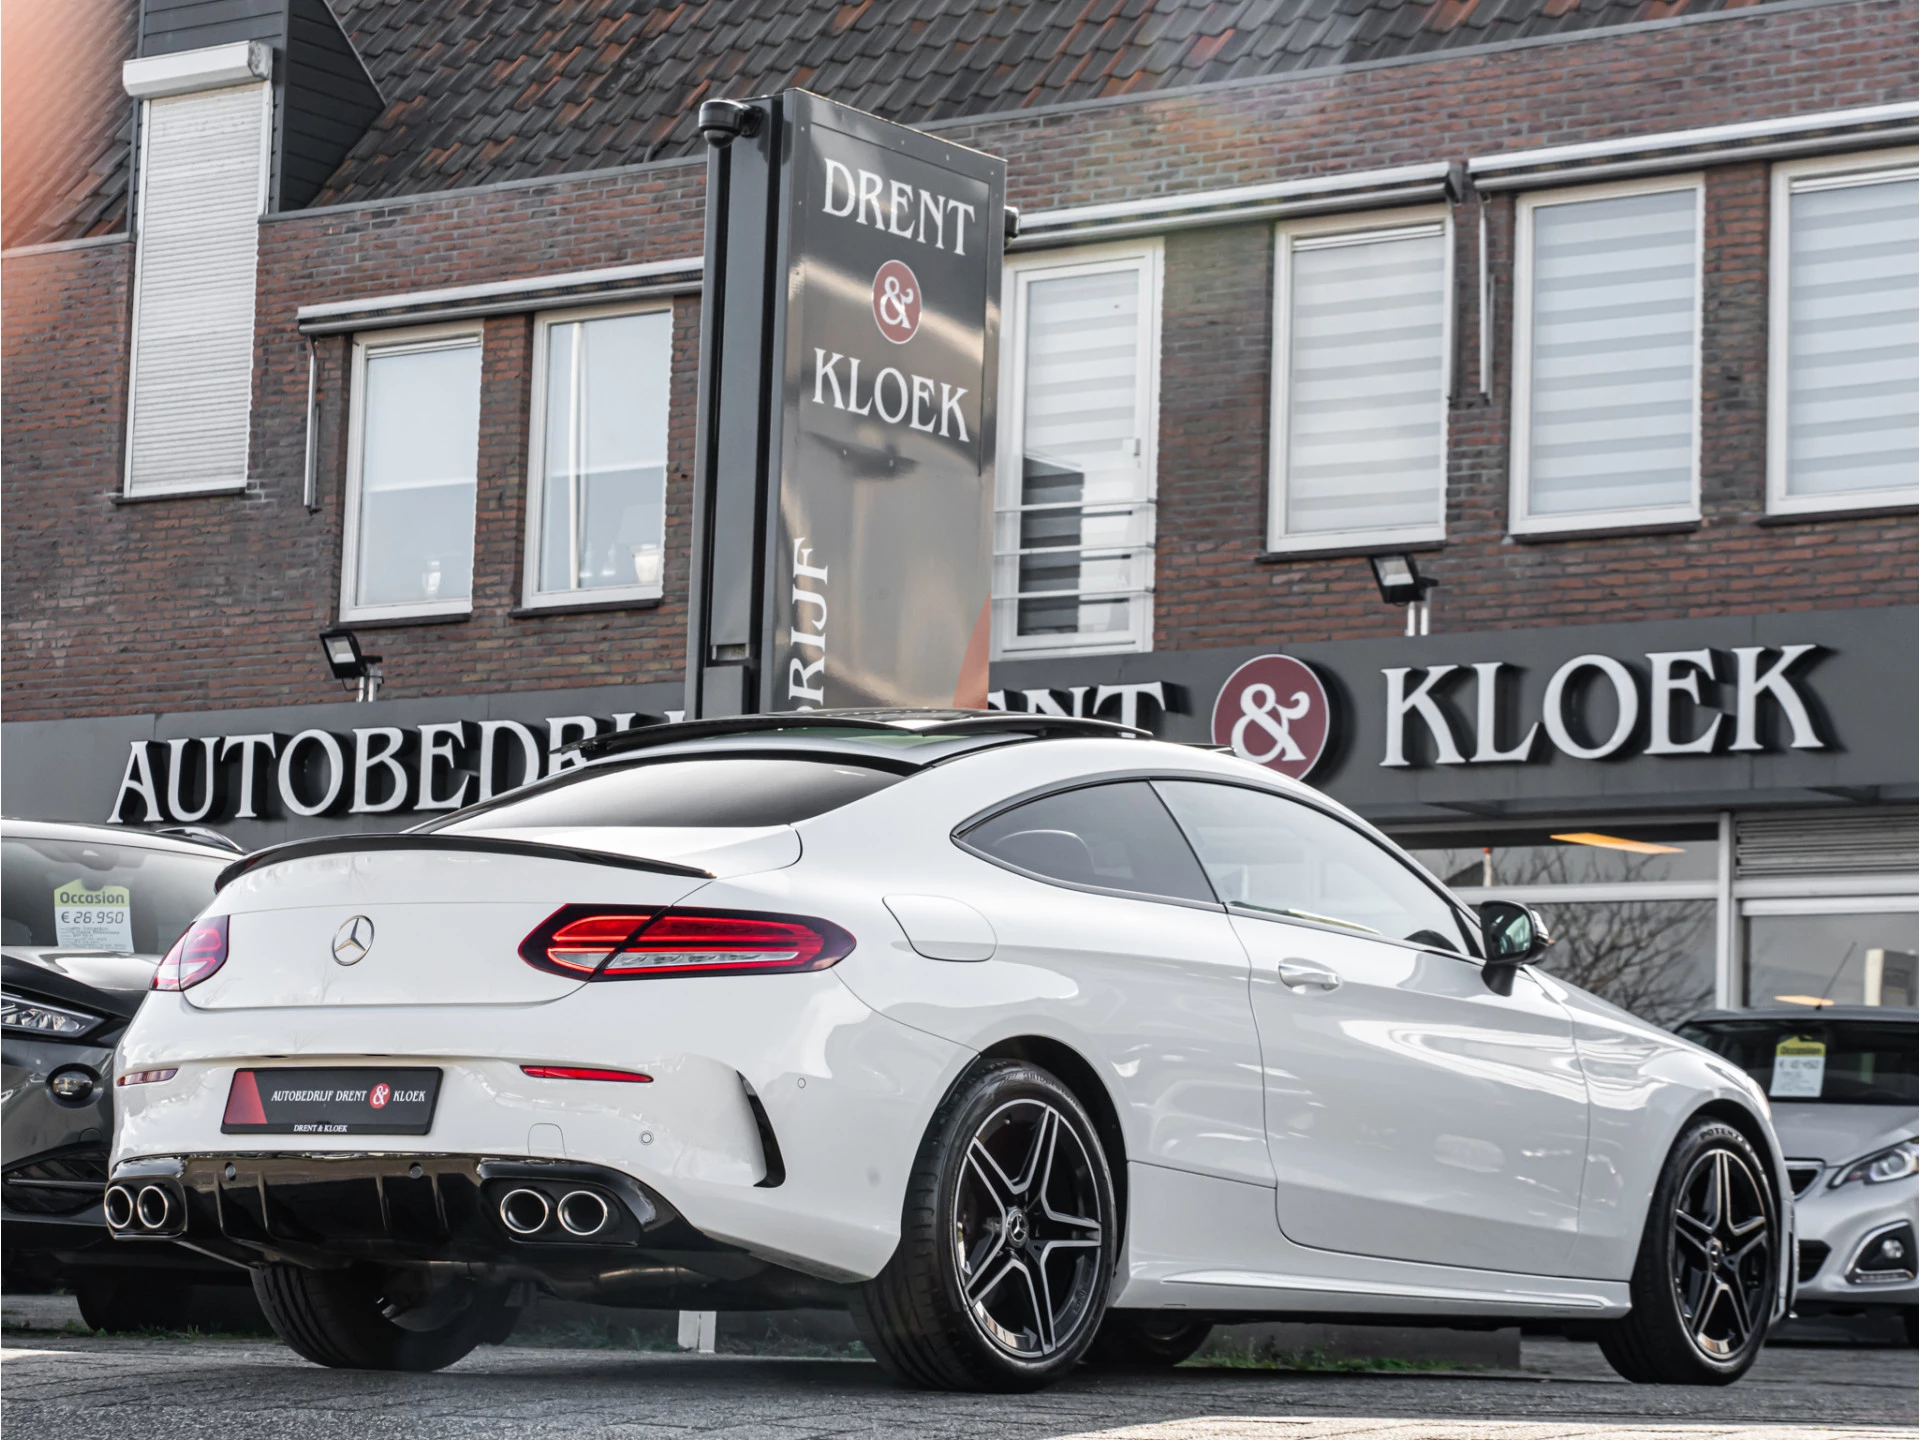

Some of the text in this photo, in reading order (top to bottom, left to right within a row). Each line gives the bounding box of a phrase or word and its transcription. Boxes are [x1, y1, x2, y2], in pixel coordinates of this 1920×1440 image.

[822, 157, 976, 257] DRENT
[878, 275, 914, 329] &
[811, 346, 971, 443] KLOEK
[788, 536, 828, 712] RIJF
[106, 710, 686, 825] AUTOBEDR
[1231, 683, 1310, 764] &
[1379, 644, 1827, 768] KLOEK
[60, 891, 125, 904] Occasion
[271, 1085, 426, 1105] AUTOBEDRIJF DRENT & KLOEK
[294, 1124, 317, 1132] DRENT
